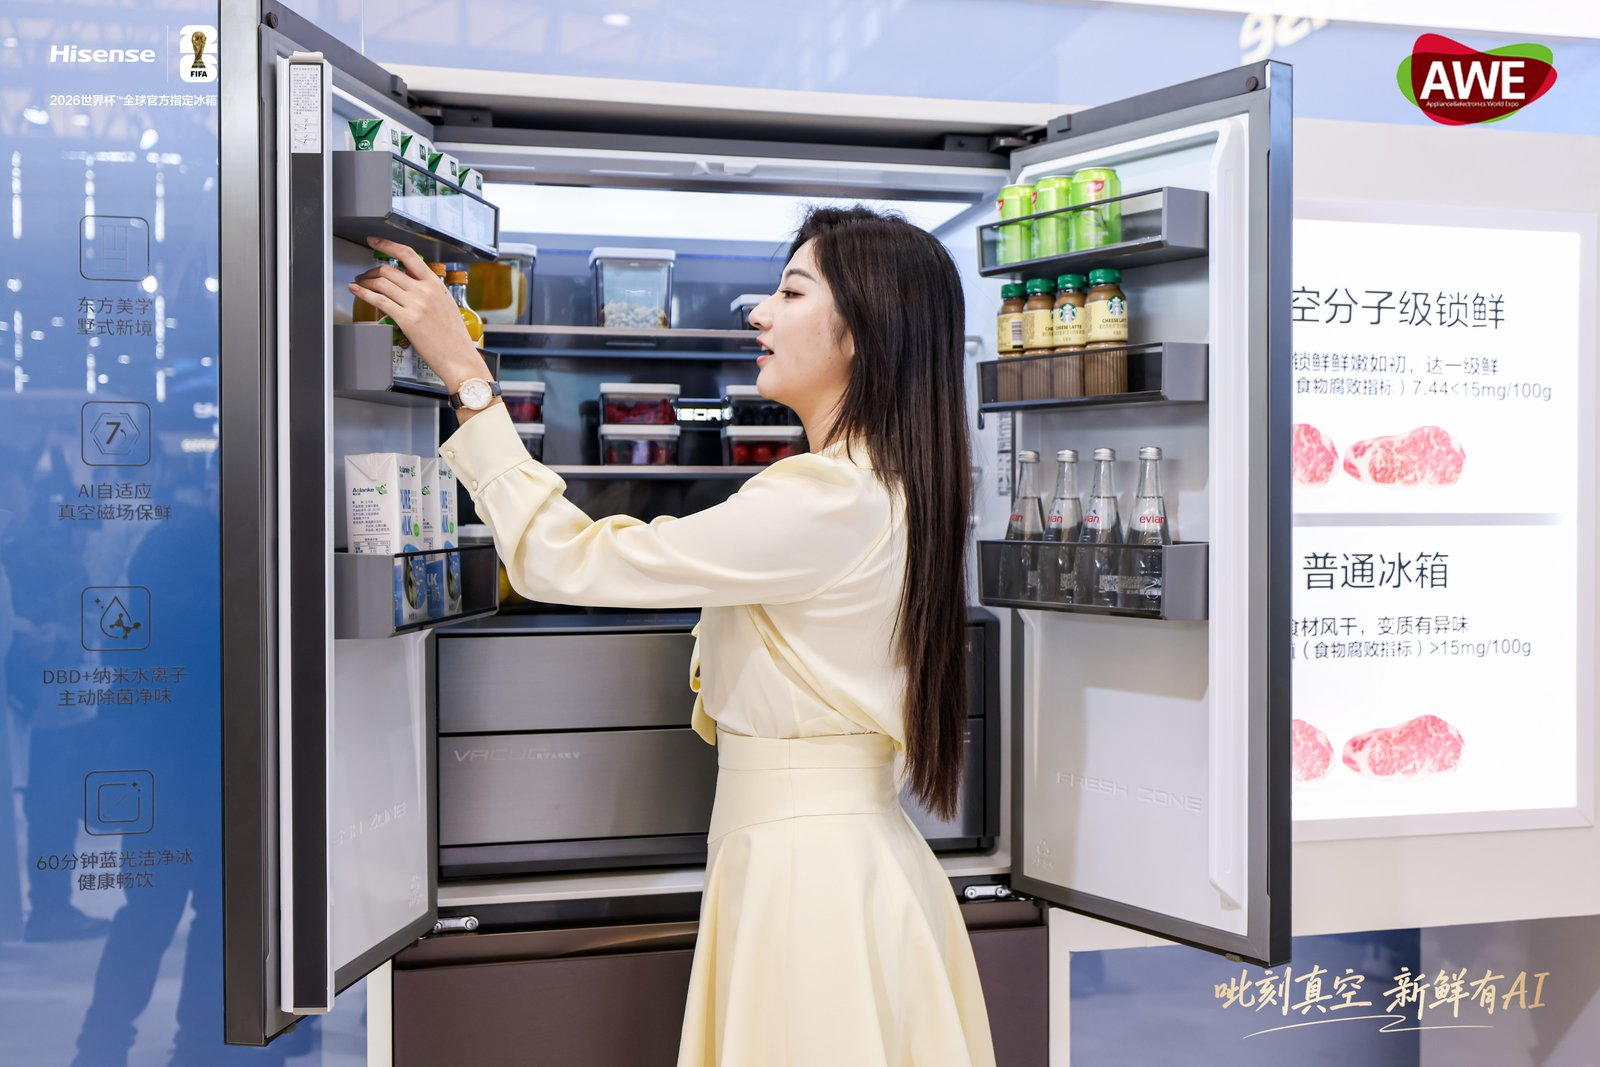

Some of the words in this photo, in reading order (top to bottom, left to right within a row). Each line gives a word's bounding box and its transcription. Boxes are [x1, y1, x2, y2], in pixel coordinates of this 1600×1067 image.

[77, 296, 153, 315] 东方美学
[1292, 286, 1505, 329] 空分子级锁鲜
[77, 318, 153, 337] 墅式新境
[78, 482, 153, 500] AI自适应
[58, 504, 172, 521] 真空磁场保鲜
[1303, 552, 1449, 590] 普通冰箱
[42, 666, 188, 685] DBD+纳米水离子
[58, 689, 173, 707] 主动除菌净味
[1056, 771, 1128, 798] FRESH
[1136, 785, 1202, 814] ZONE
[36, 849, 194, 871] 60分钟蓝光洁净冰
[78, 872, 154, 891] 健康畅饮
